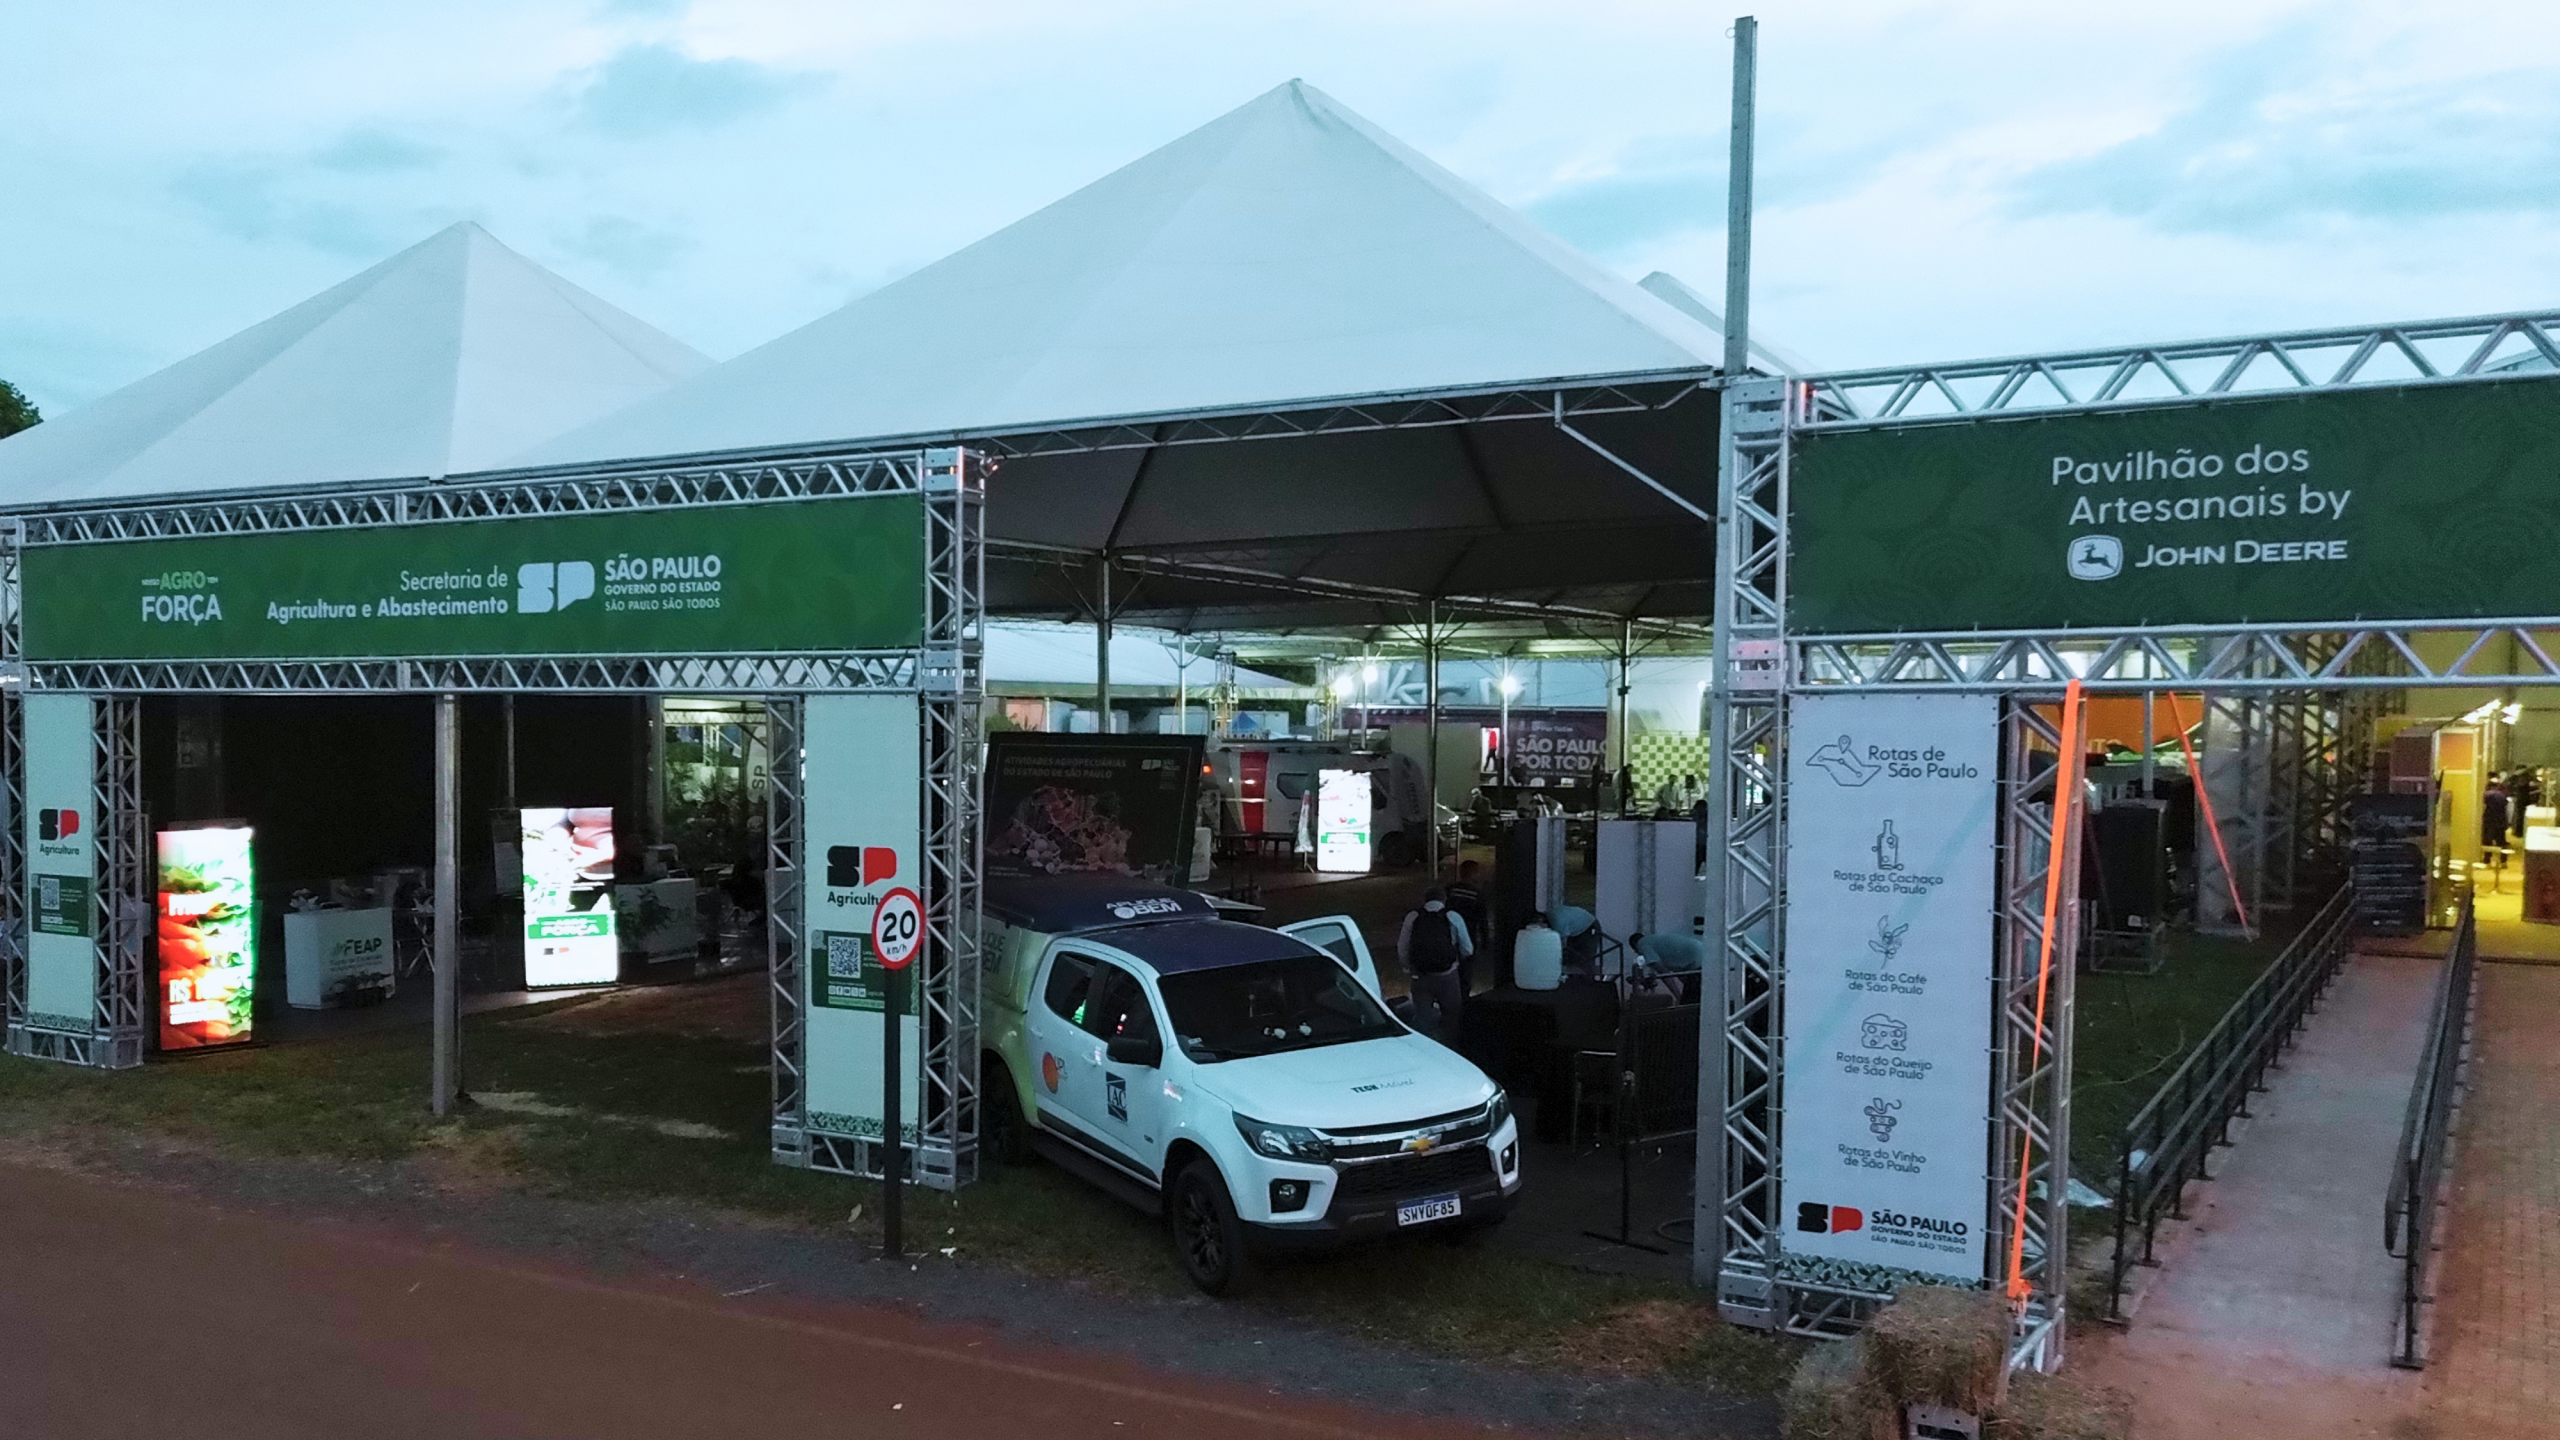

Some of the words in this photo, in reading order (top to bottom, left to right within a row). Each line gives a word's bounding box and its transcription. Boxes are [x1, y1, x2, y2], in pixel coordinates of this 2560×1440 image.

[2052, 448, 2223, 485] Pavilhão
[2235, 444, 2309, 475] dos
[2068, 486, 2287, 525] Artesanais
[2299, 483, 2351, 520] by
[2135, 545, 2225, 568] JOHN
[2234, 540, 2348, 563] DEERE
[604, 553, 648, 581] SÃO
[652, 554, 721, 580] PAULO
[160, 570, 206, 590] AGRO
[400, 568, 482, 591] Secretaria
[487, 565, 508, 588] de
[604, 583, 657, 596] GOVERNO
[660, 582, 676, 594] DO
[679, 581, 721, 593] ESTADO
[142, 593, 223, 626] FORÇA
[267, 599, 357, 625] Agricultura
[361, 601, 372, 618] e
[377, 595, 509, 617] Abastecimento
[605, 599, 625, 612] SÃO
[628, 600, 659, 611] PAULO
[662, 597, 684, 610] SÃO
[686, 598, 721, 609] TODOS
[1516, 734, 1553, 753] SÃO
[1868, 745, 1918, 761] Rotas
[1922, 746, 1945, 761] de
[1516, 753, 1551, 769] POR
[1888, 762, 1922, 778] São
[1927, 763, 1978, 778] Paulo
[1017, 767, 1050, 777] ESTADO
[1051, 768, 1062, 777] DE
[1064, 767, 1081, 778] SÃO
[1083, 769, 1113, 779] PAULO
[39, 843, 80, 856] Agricultura
[1833, 870, 1866, 882] Rotas
[1868, 872, 1885, 883] da
[1888, 872, 1944, 887] Cachaça
[1849, 883, 1864, 892] de
[1867, 881, 1890, 893] São
[1893, 883, 1927, 895] Paulo
[827, 890, 881, 907] Agricultu
[1132, 902, 1182, 915] BEM
[882, 910, 917, 943] 20
[344, 937, 382, 957] FEAP
[886, 945, 908, 955] km/h
[1845, 969, 1877, 981] Rotas
[1880, 972, 1896, 983] do
[1898, 972, 1927, 984] Café
[1848, 980, 1864, 991] de
[1866, 981, 1888, 992] São
[1891, 983, 1924, 995] Paulo
[1836, 1051, 1870, 1064] Rotas
[1872, 1055, 1889, 1066] do
[1891, 1056, 1933, 1071] Queijo
[1844, 1064, 1860, 1074] de
[1863, 1064, 1886, 1077] São
[1889, 1067, 1924, 1080] Paulo
[1106, 1084, 1127, 1109] IAC
[1838, 1143, 1871, 1157] Rotas
[1873, 1148, 1889, 1160] do
[1892, 1150, 1927, 1163] Vinho
[1844, 1156, 1859, 1166] de
[1861, 1156, 1885, 1169] São
[1886, 1159, 1921, 1174] Paulo
[1871, 1209, 1907, 1227] SÃO
[1910, 1216, 1967, 1236] PAULO
[1871, 1225, 1914, 1238] GOVERNO
[1917, 1231, 1931, 1239] DO
[1932, 1233, 1967, 1245] ESTADO
[1871, 1234, 1888, 1243] SÃO
[1890, 1237, 1915, 1247] PAULO
[1918, 1240, 1935, 1250] SÃO
[1938, 1244, 1967, 1254] TODOS
